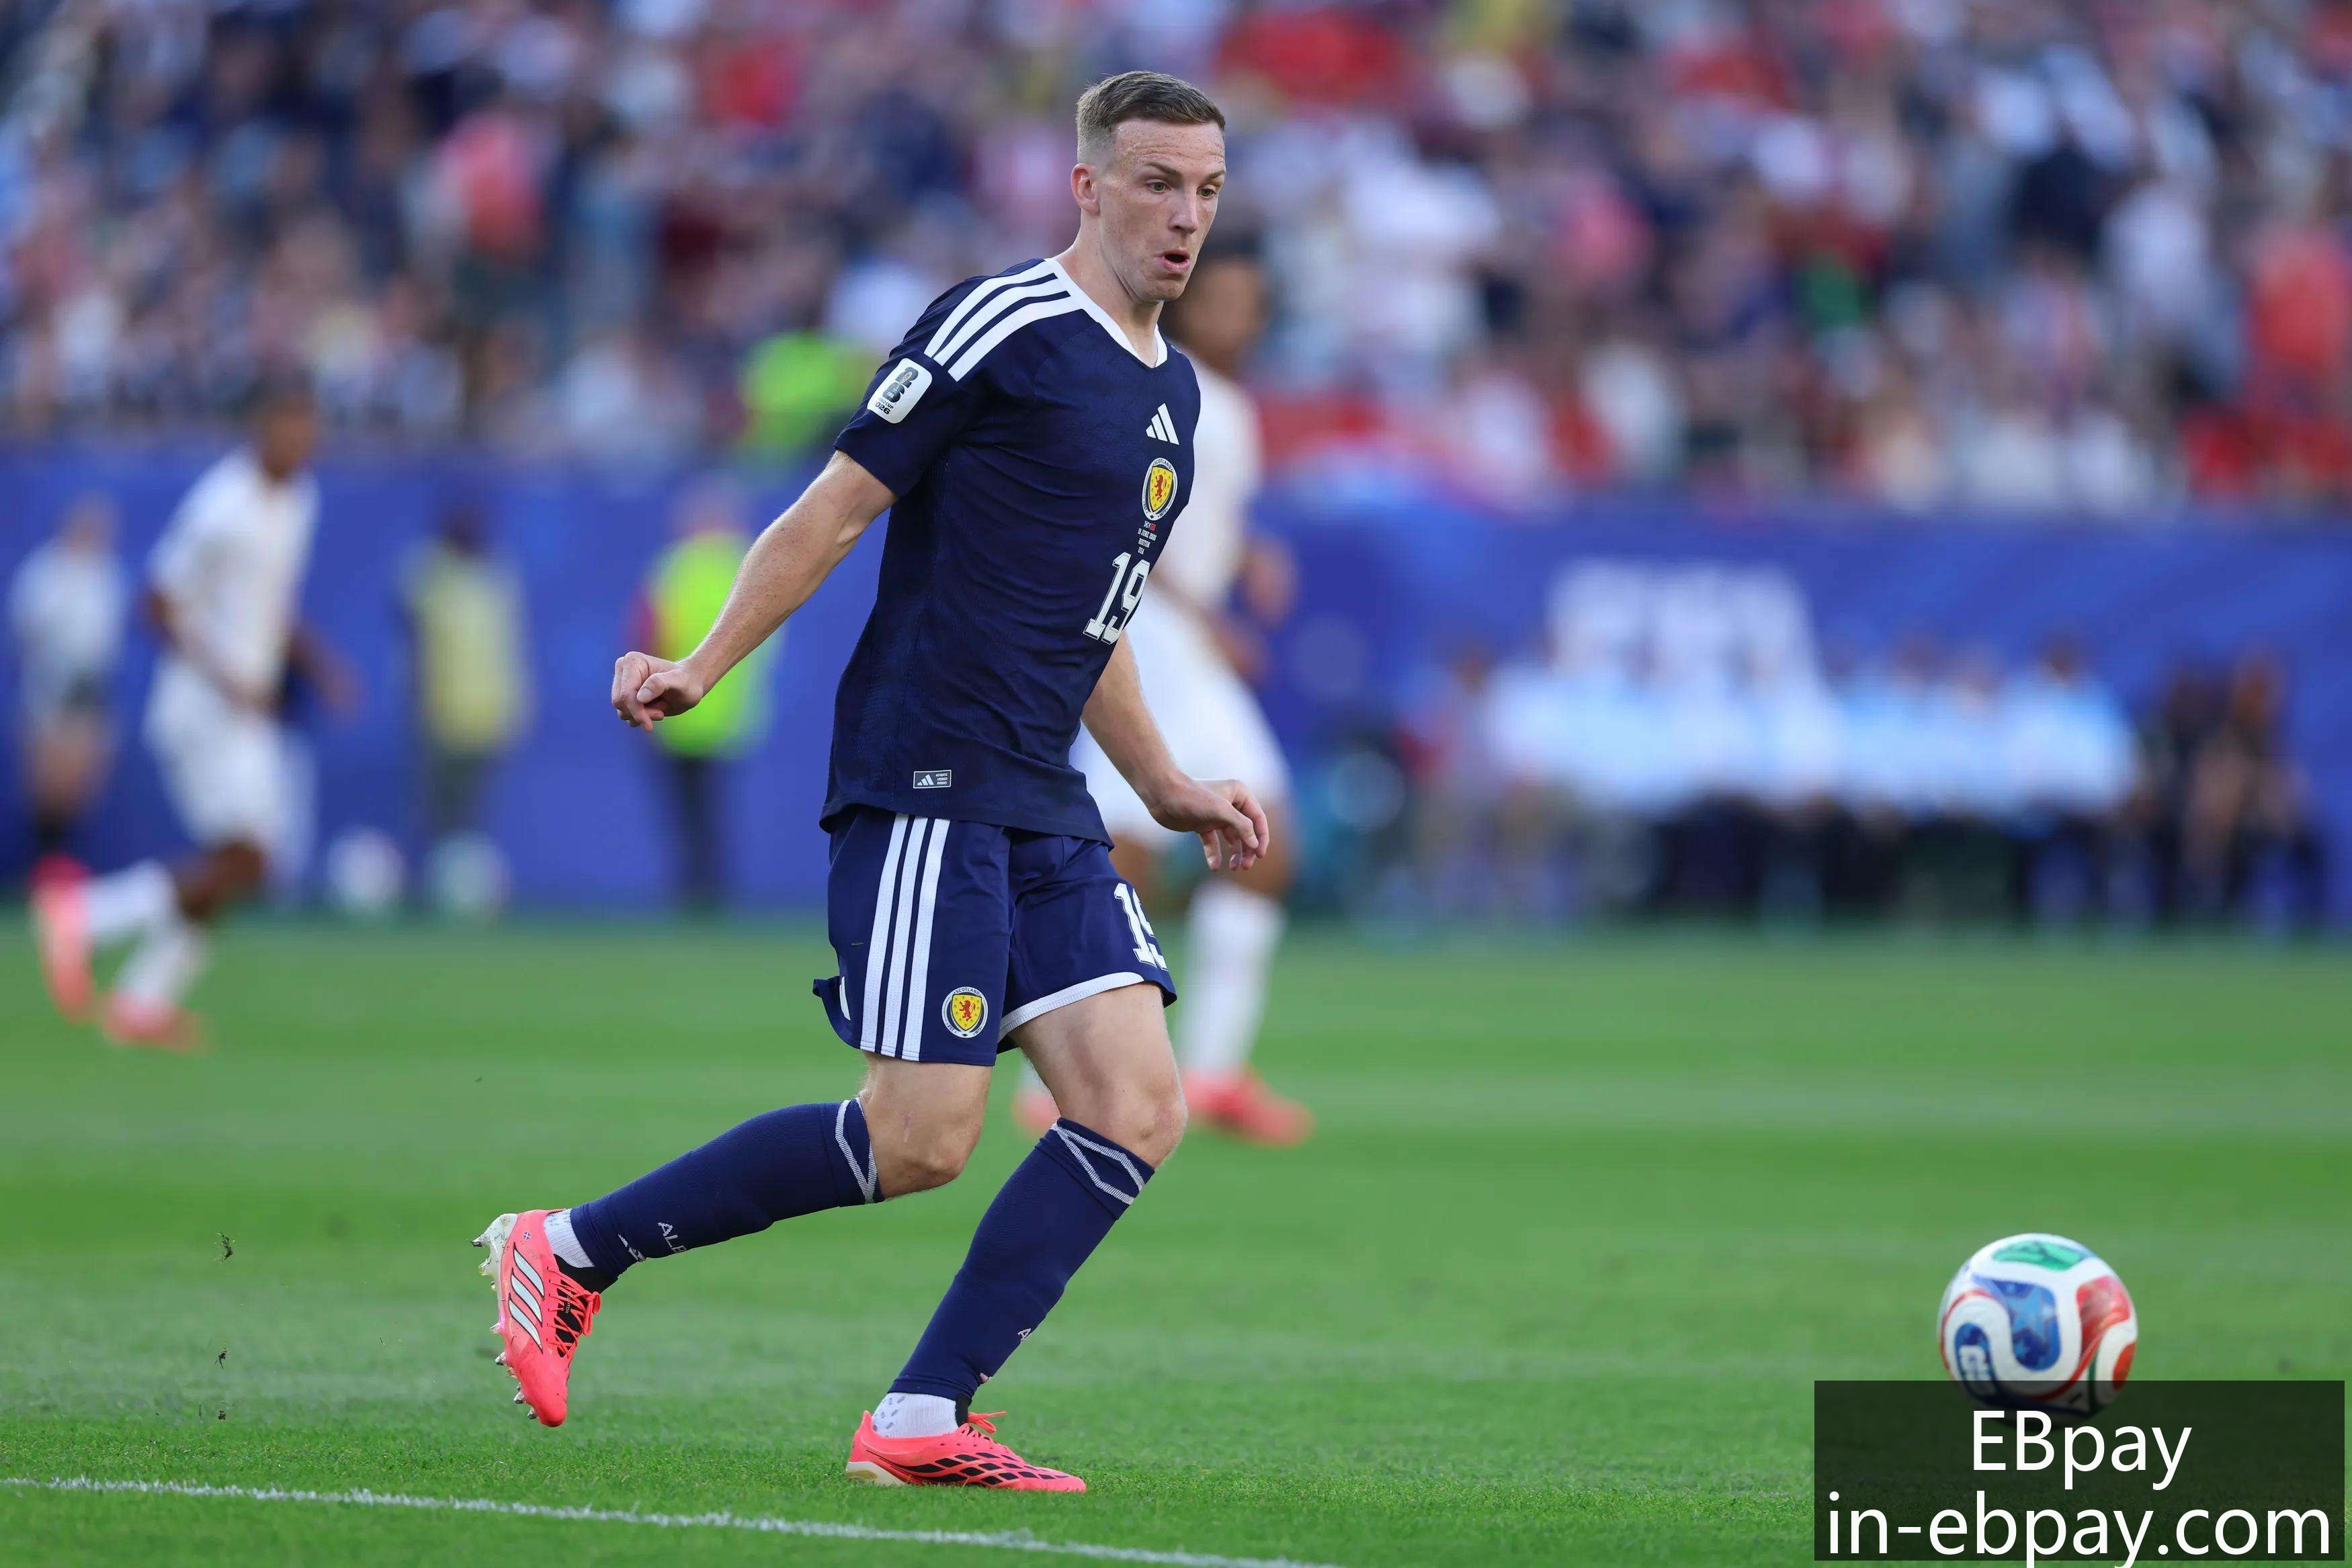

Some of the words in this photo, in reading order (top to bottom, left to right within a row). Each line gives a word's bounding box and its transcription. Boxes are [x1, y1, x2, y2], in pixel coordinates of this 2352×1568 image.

[1154, 458, 1172, 470] SCOTLAND
[1083, 552, 1150, 645] 19
[956, 987, 980, 995] SCOTLAND
[947, 1024, 955, 1032] EST
